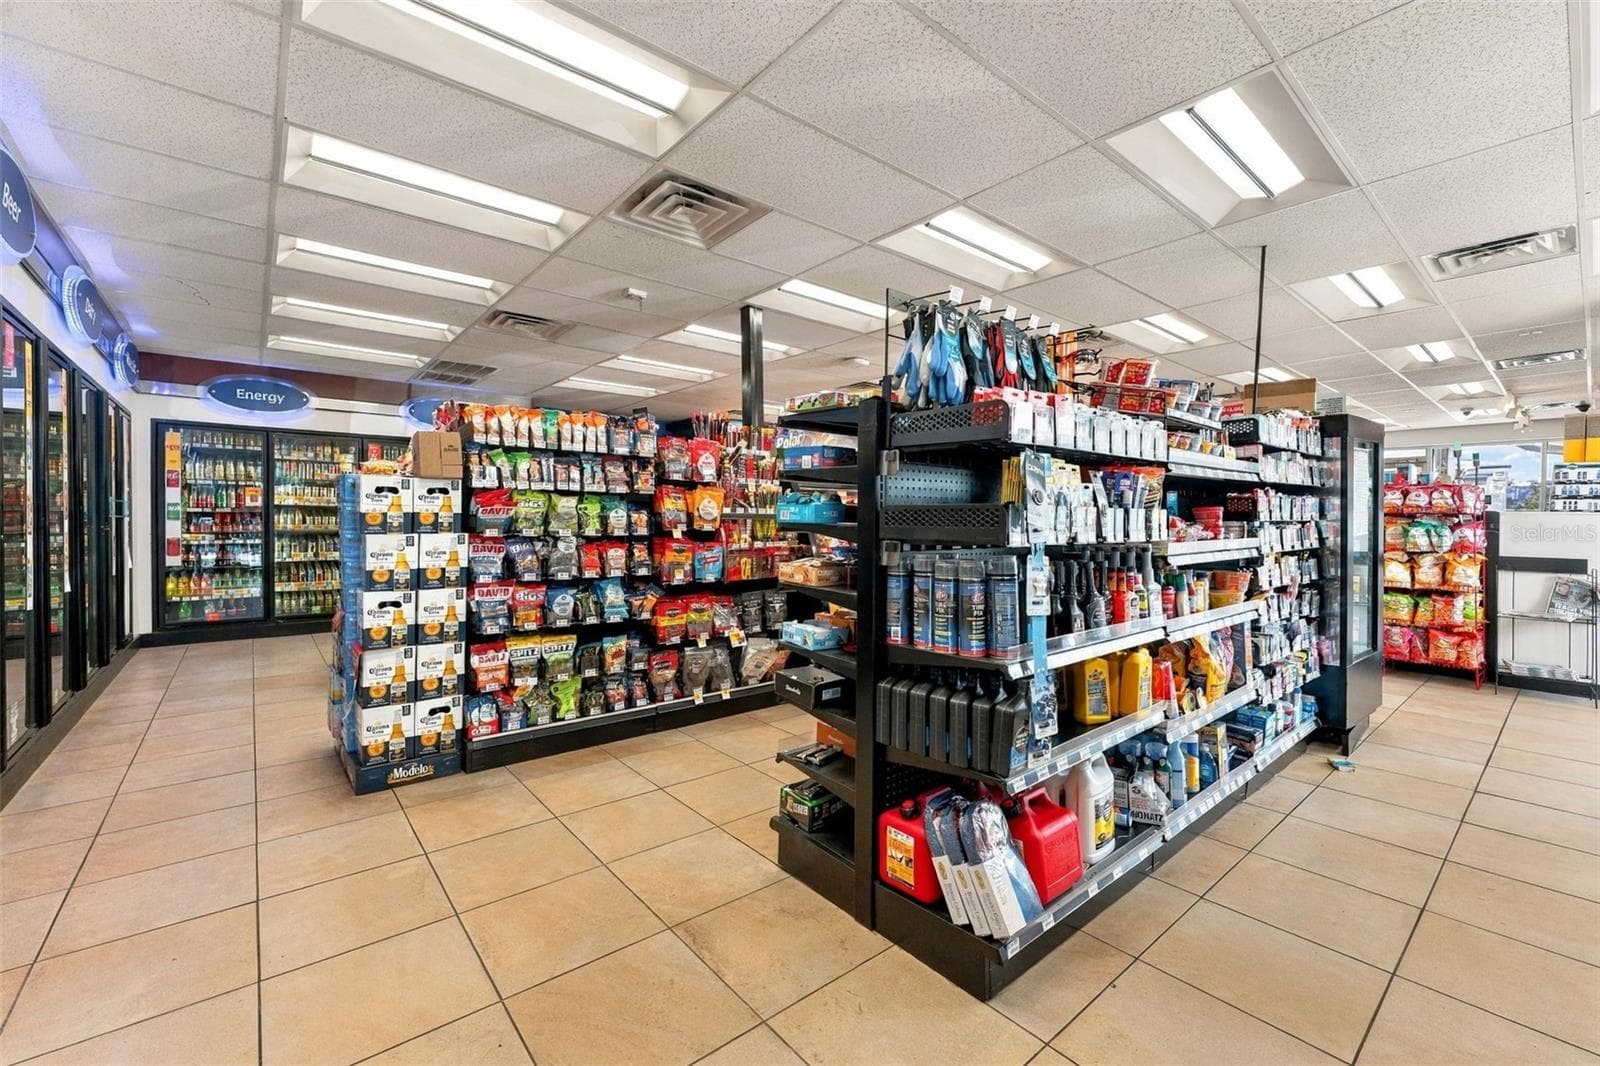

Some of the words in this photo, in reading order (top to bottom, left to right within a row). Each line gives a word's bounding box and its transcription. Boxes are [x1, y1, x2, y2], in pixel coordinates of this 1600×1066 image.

[2, 181, 22, 223] Beer
[236, 388, 286, 404] Energy
[776, 432, 803, 448] Polar
[472, 545, 505, 553] DAVID
[477, 588, 510, 598] DAVID
[511, 647, 539, 658] SPITZ
[544, 643, 574, 654] SPITZ
[393, 763, 429, 779] Modelo
